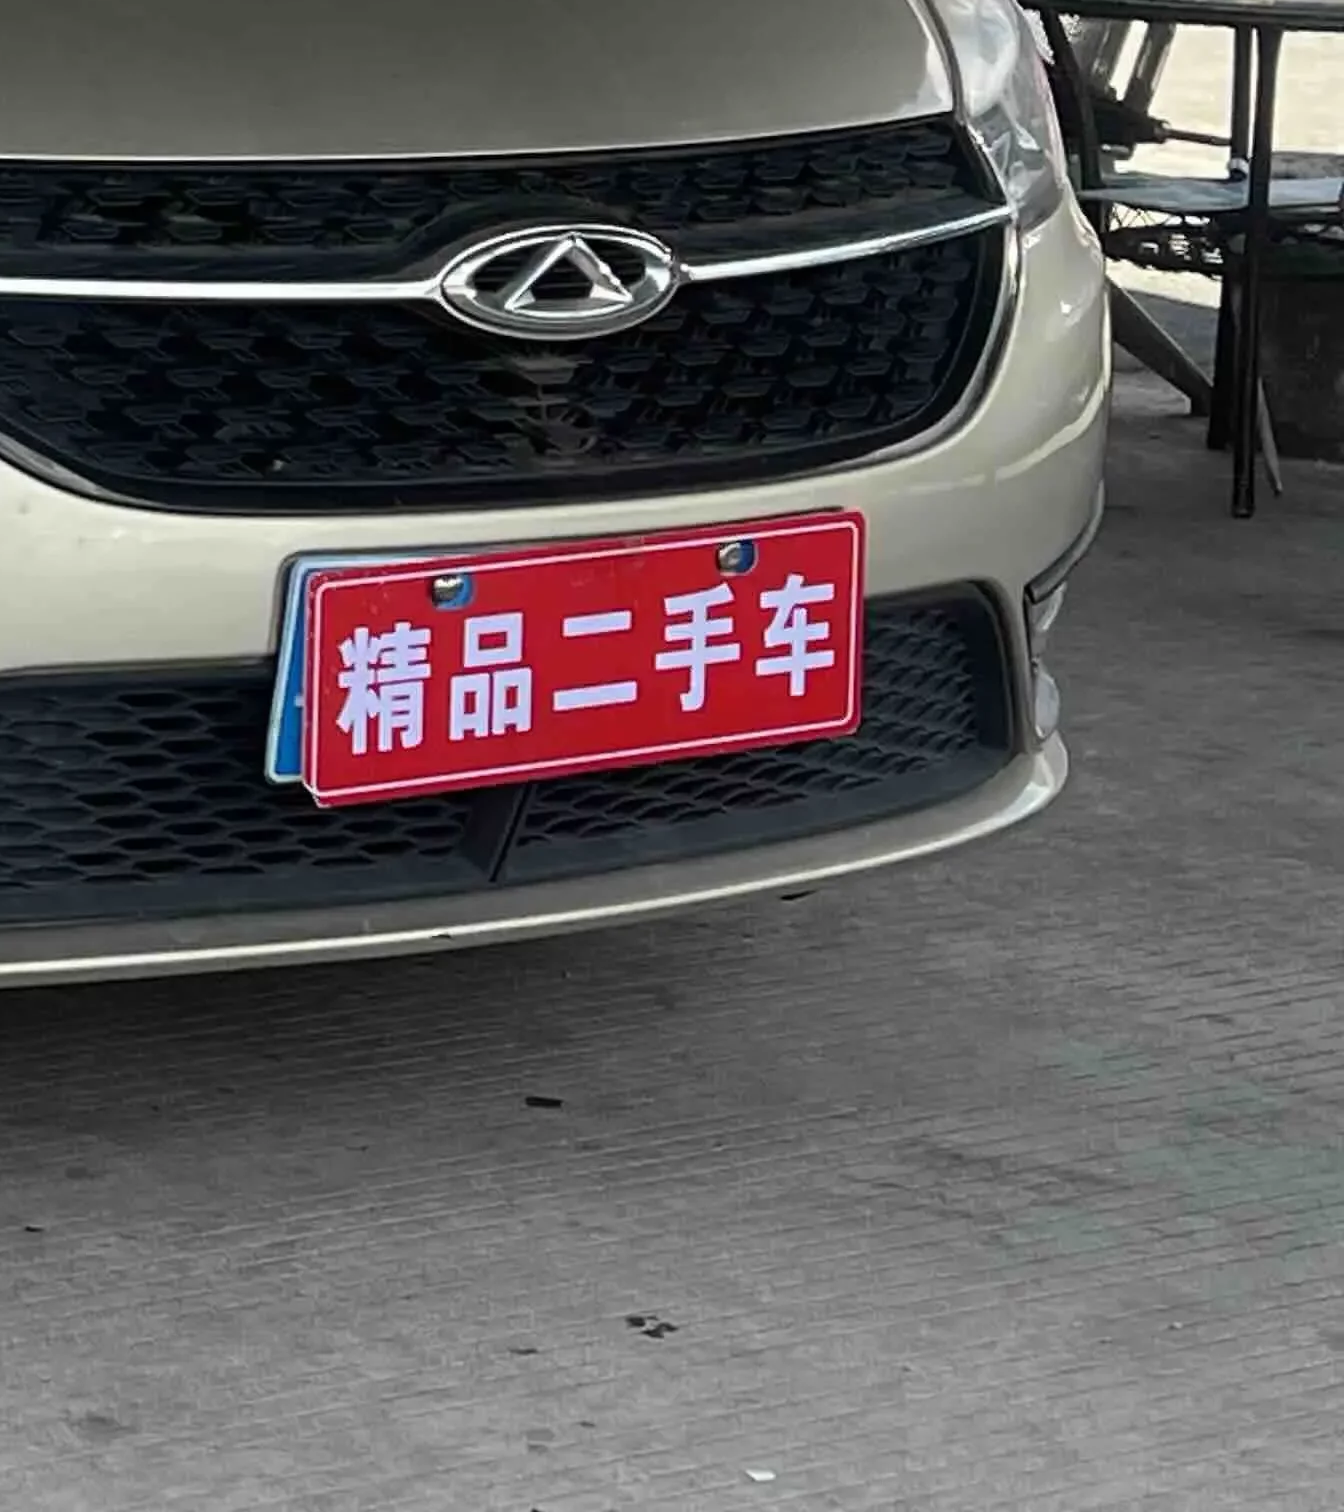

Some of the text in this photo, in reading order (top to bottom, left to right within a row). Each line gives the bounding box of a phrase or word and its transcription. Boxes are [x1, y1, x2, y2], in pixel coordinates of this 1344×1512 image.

[336, 574, 836, 755] 精品二手车
